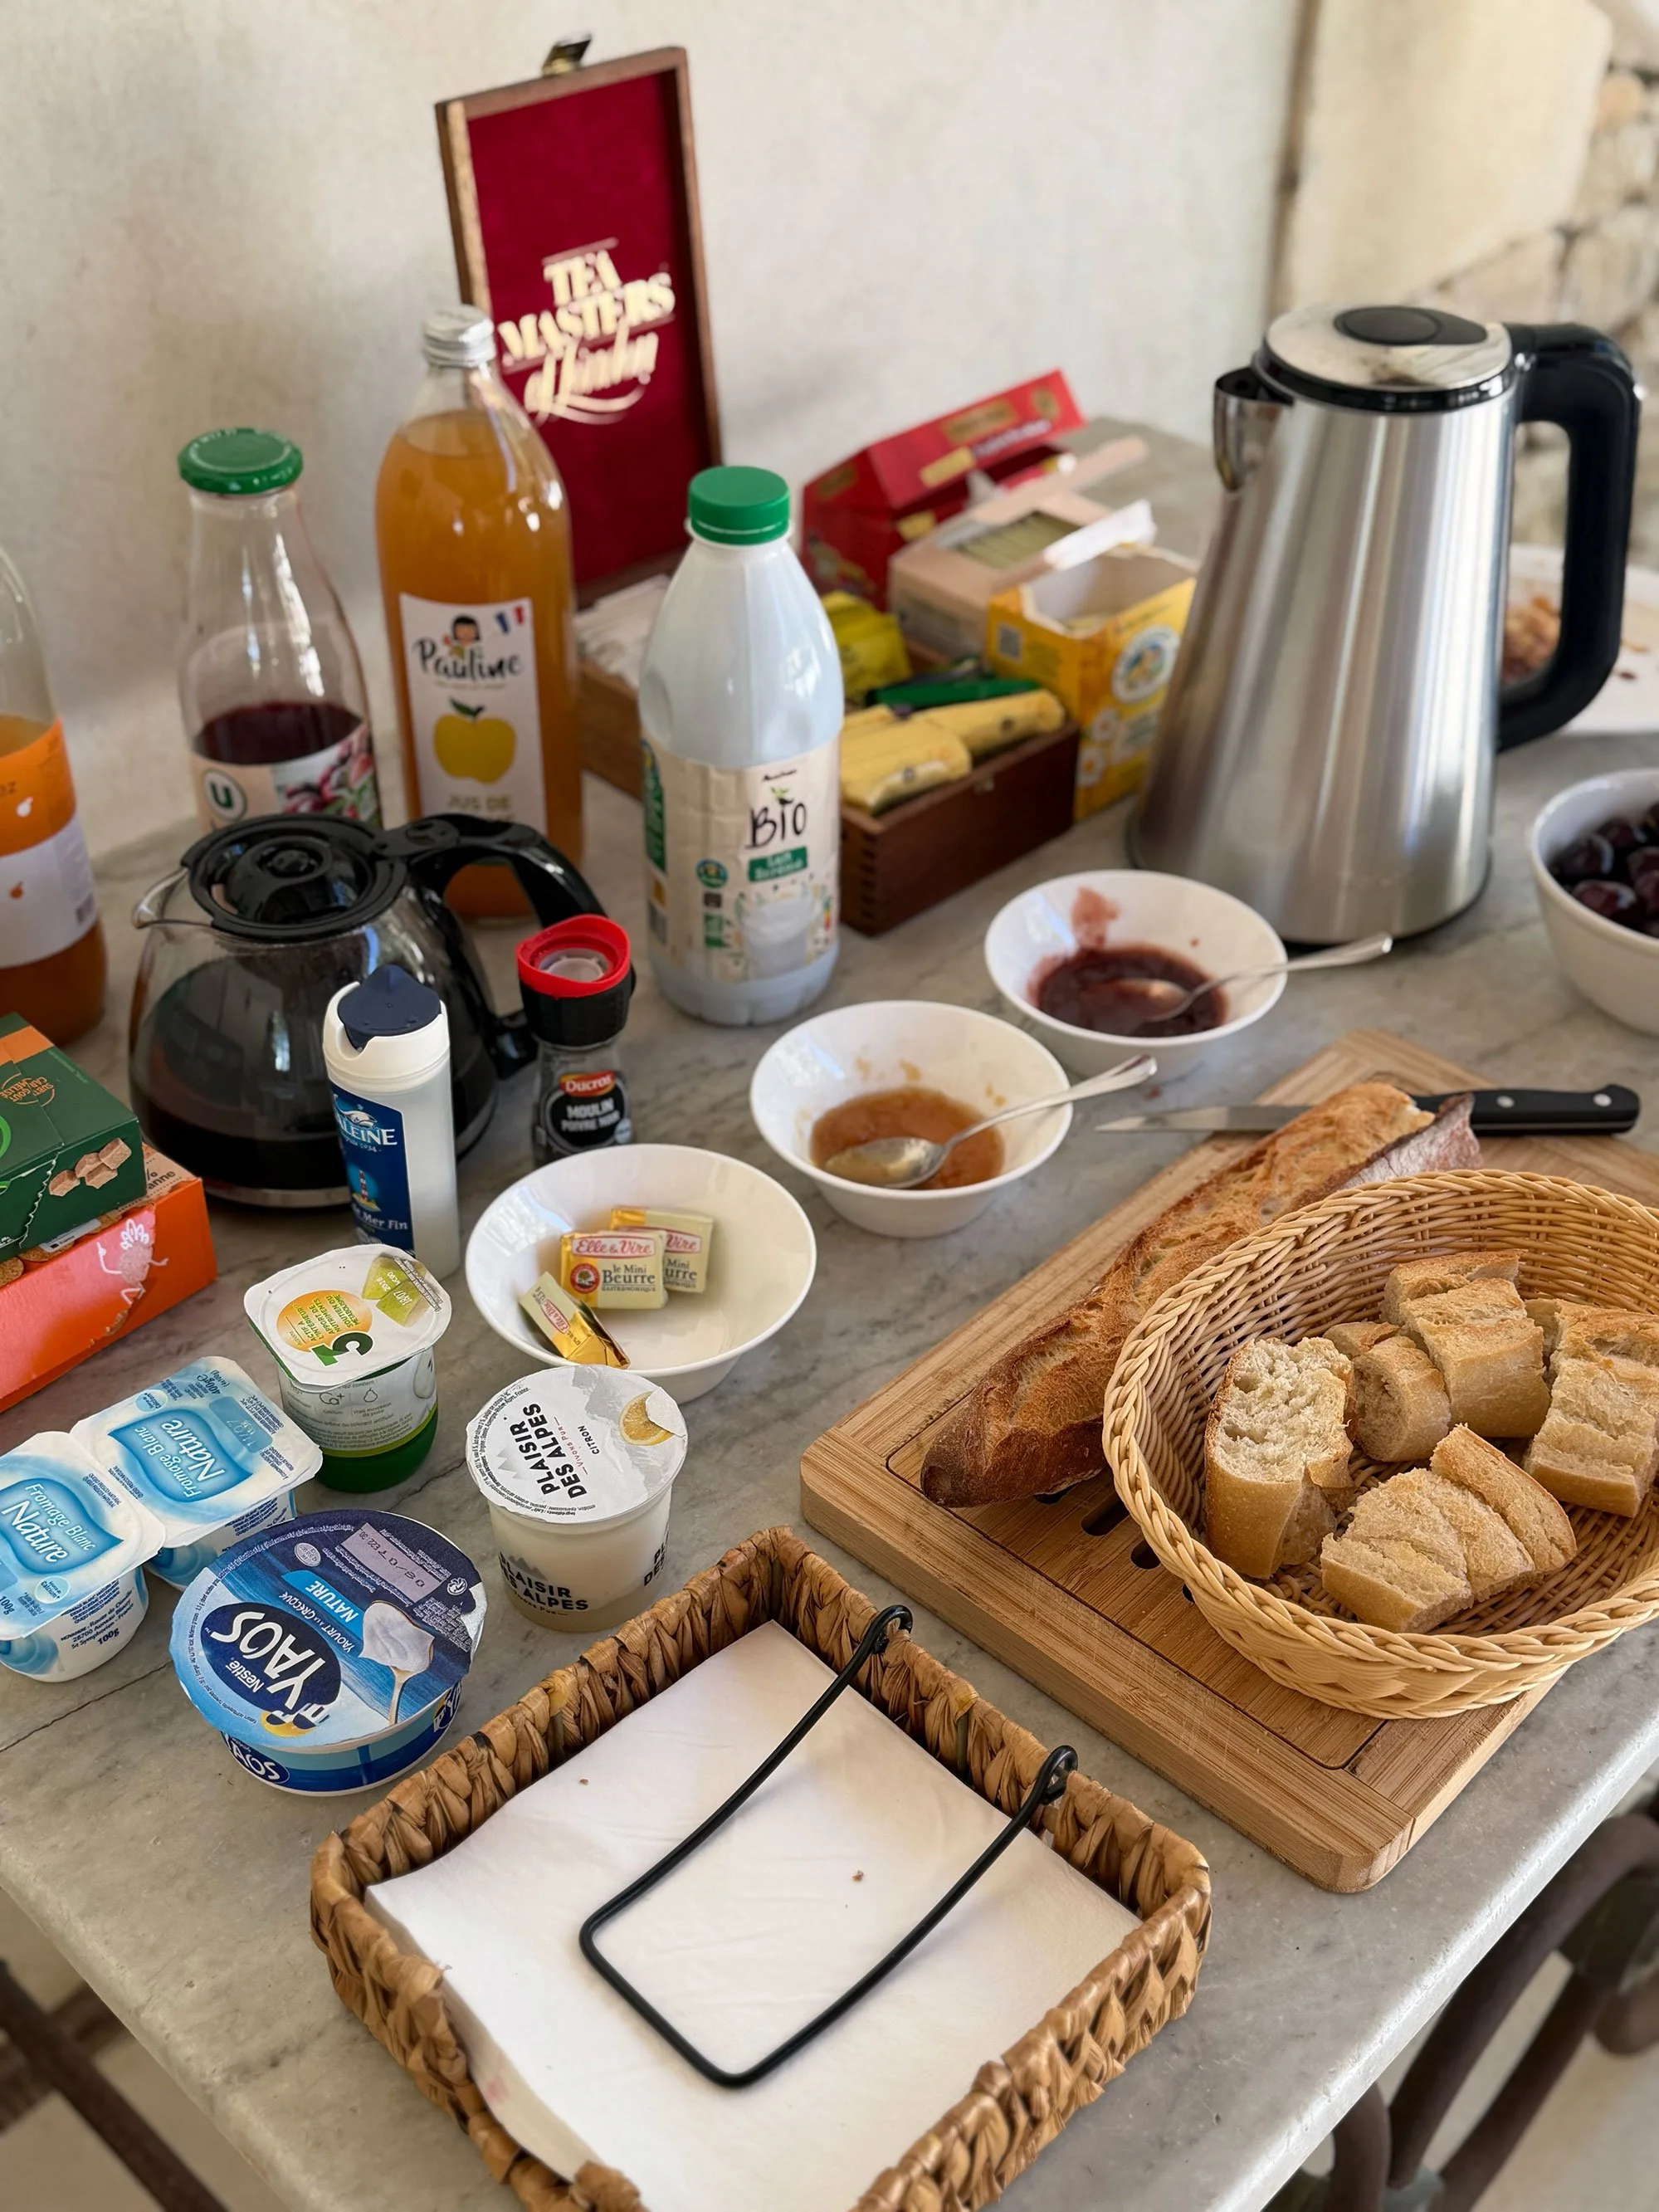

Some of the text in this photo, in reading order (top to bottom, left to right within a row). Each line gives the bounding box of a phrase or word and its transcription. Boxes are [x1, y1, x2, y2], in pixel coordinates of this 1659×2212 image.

[543, 249, 624, 308] TEA
[498, 271, 676, 360] MASTERS
[412, 636, 525, 682] Pauline
[446, 794, 512, 811] JUS DE
[565, 1075, 612, 1092] Ducros
[567, 1098, 614, 1119] MOULIN
[363, 1213, 384, 1228] Mer
[388, 1221, 408, 1230] Fin
[575, 1239, 606, 1255] Elle
[620, 1239, 653, 1255] Vire
[666, 1235, 697, 1252] Vire
[602, 1269, 656, 1284] Beurre
[612, 1263, 647, 1274] le Mini
[666, 1258, 690, 1269] Mini
[308, 1303, 336, 1336] APPORT DE
[313, 1297, 342, 1333] NUTRIMENTS
[325, 1295, 354, 1329] SOUTIEN DU
[301, 1326, 318, 1342] ACTIF
[161, 1419, 226, 1482] Nature
[523, 1404, 588, 1499] DES ALPES
[578, 1425, 600, 1455] CITRON
[134, 1427, 202, 1497] Fromage Blanc
[510, 1420, 561, 1495] PLAISIR
[2, 1500, 69, 1563] Nature
[25, 1483, 96, 1551] Fromage Blanc
[500, 1551, 572, 1599] PLAISIR
[305, 1580, 359, 1624] NATURE
[523, 1588, 588, 1610] ALPES
[96, 1628, 120, 1645] 100g
[321, 1624, 355, 1653] YAOURT
[209, 1610, 326, 1711] YAOS
[225, 1659, 266, 1693] Nestlé
